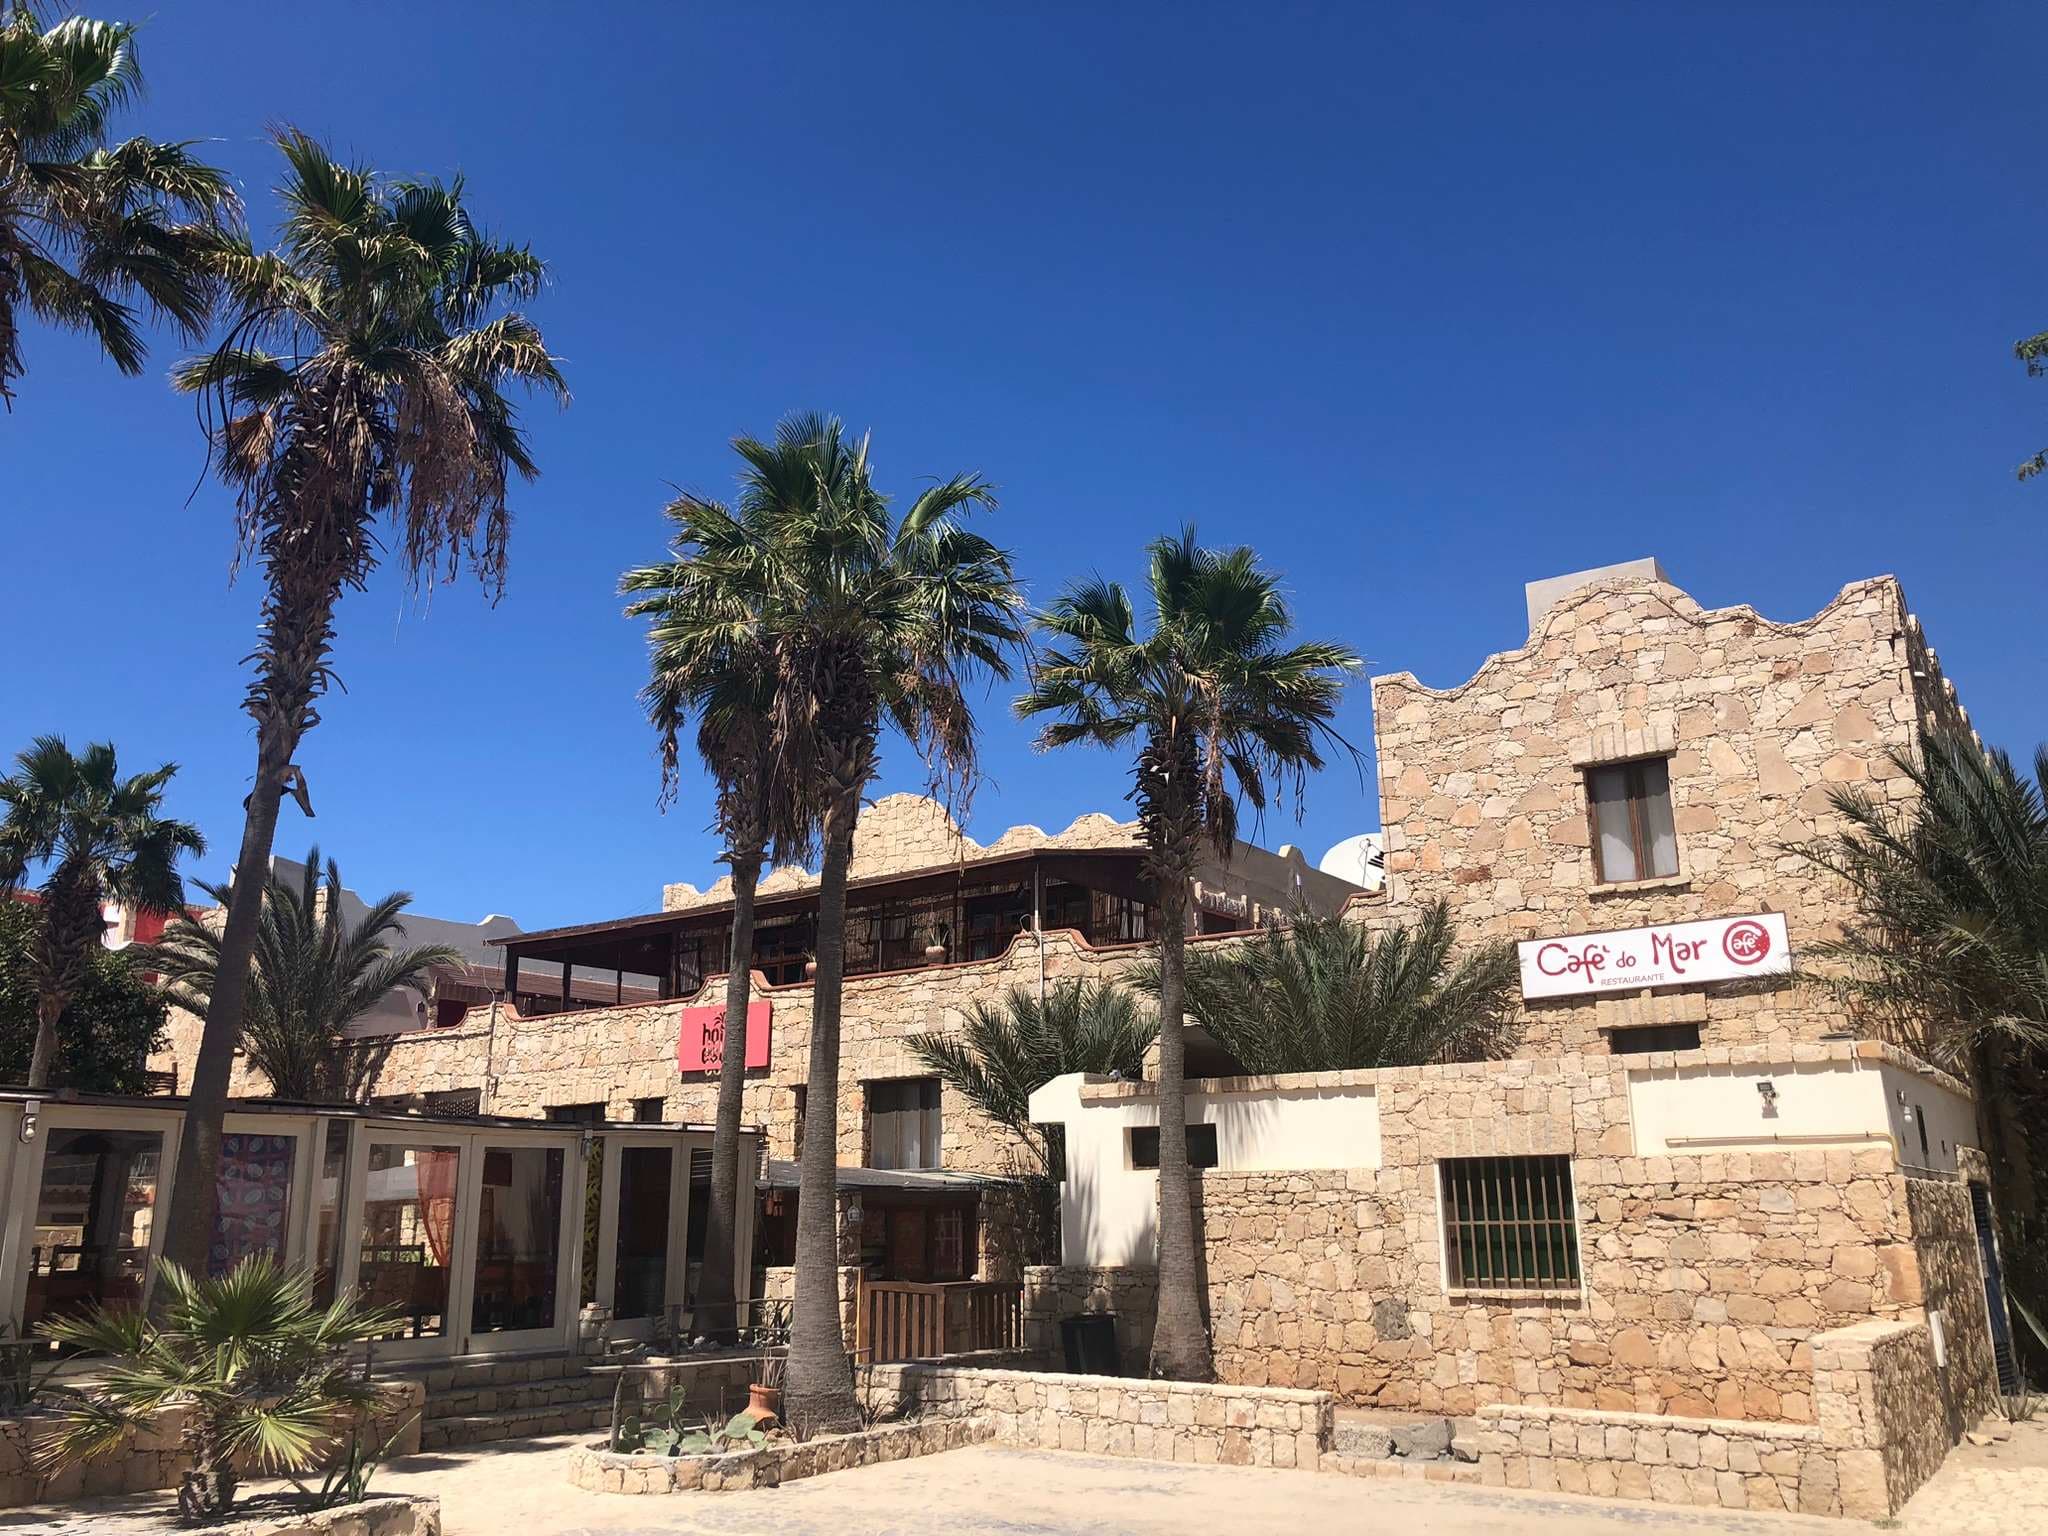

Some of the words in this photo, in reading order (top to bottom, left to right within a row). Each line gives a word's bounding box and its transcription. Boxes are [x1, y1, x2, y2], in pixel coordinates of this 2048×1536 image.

[1615, 951, 1637, 968] do
[1650, 931, 1708, 975] Mar
[1600, 973, 1665, 986] RESTAURANTE
